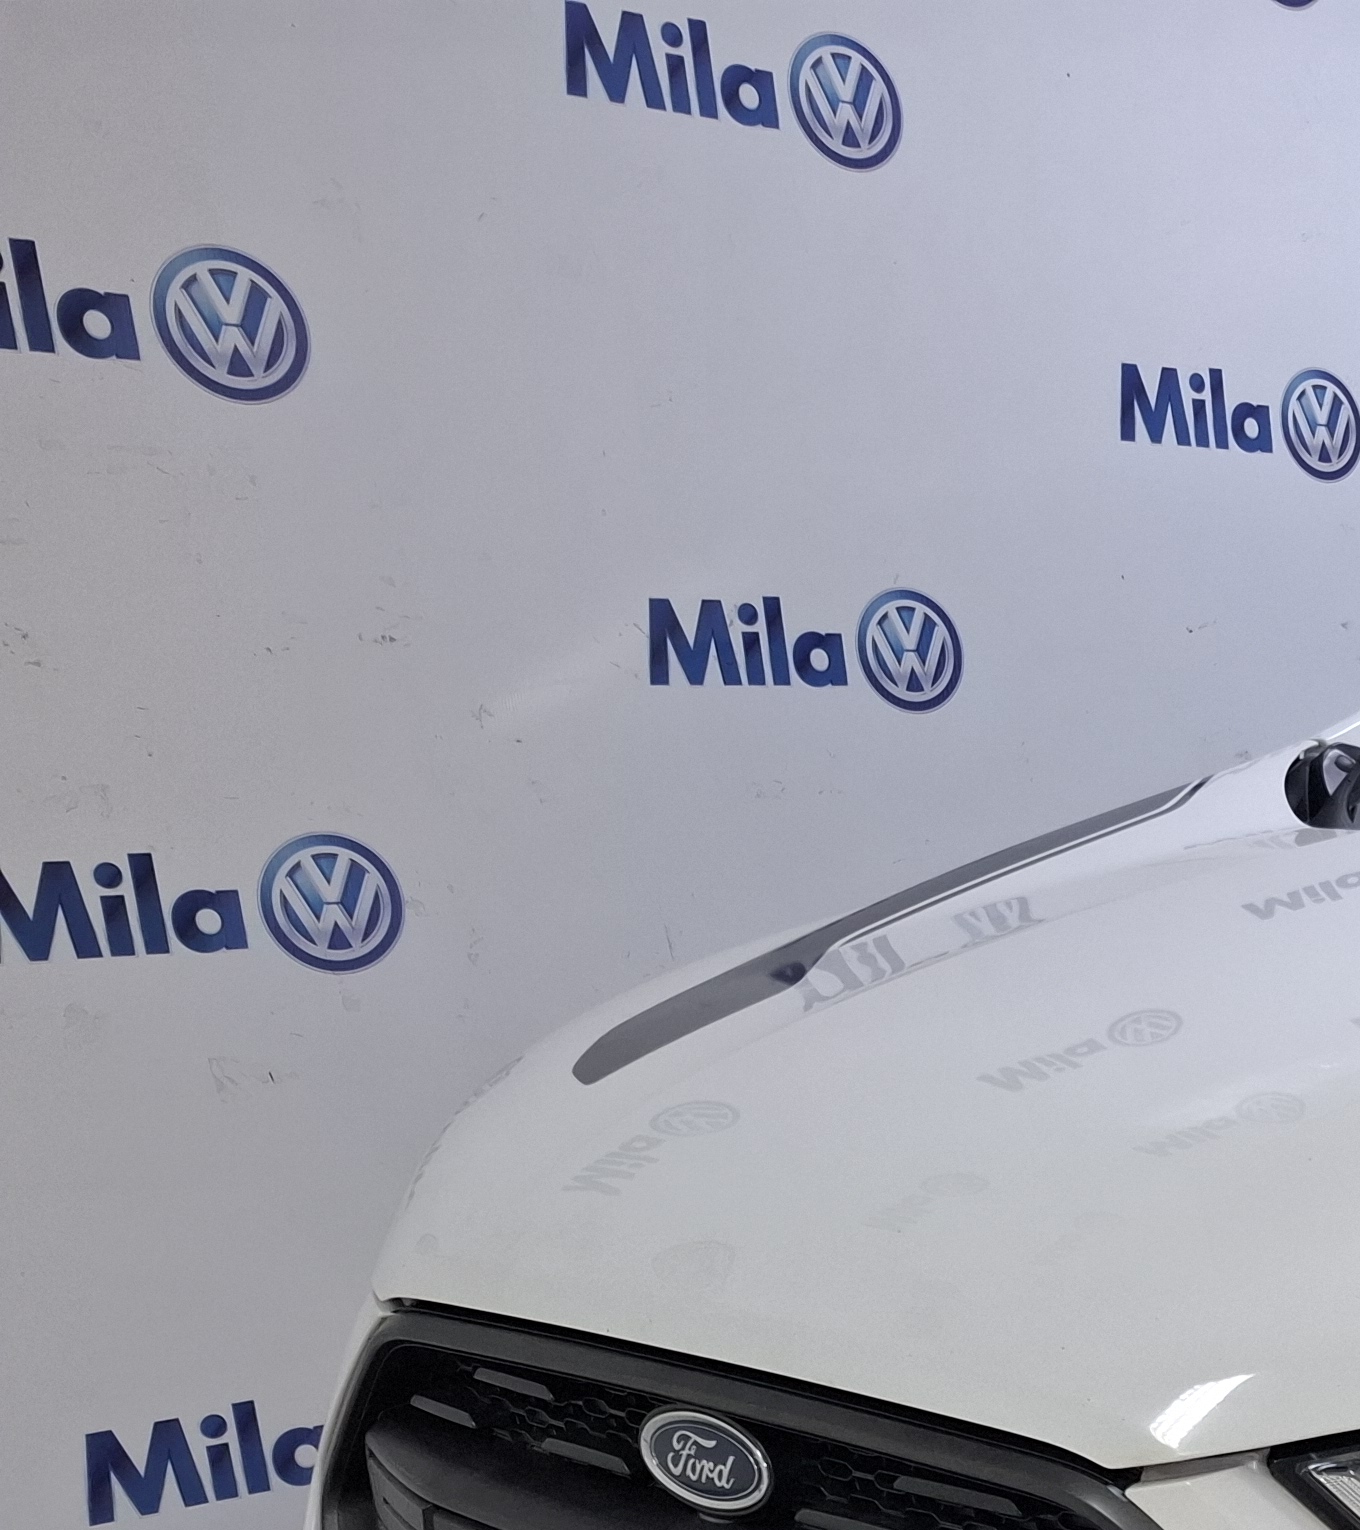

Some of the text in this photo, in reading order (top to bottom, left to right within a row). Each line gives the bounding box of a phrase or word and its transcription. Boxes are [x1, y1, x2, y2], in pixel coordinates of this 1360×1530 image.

[565, 0, 779, 129] Mila
[0, 238, 140, 360] ila
[1120, 363, 1273, 453] Mila
[649, 597, 848, 687] Mila
[0, 853, 248, 961] Mila
[86, 1400, 324, 1526] Mila
[667, 1430, 735, 1492] Ford
